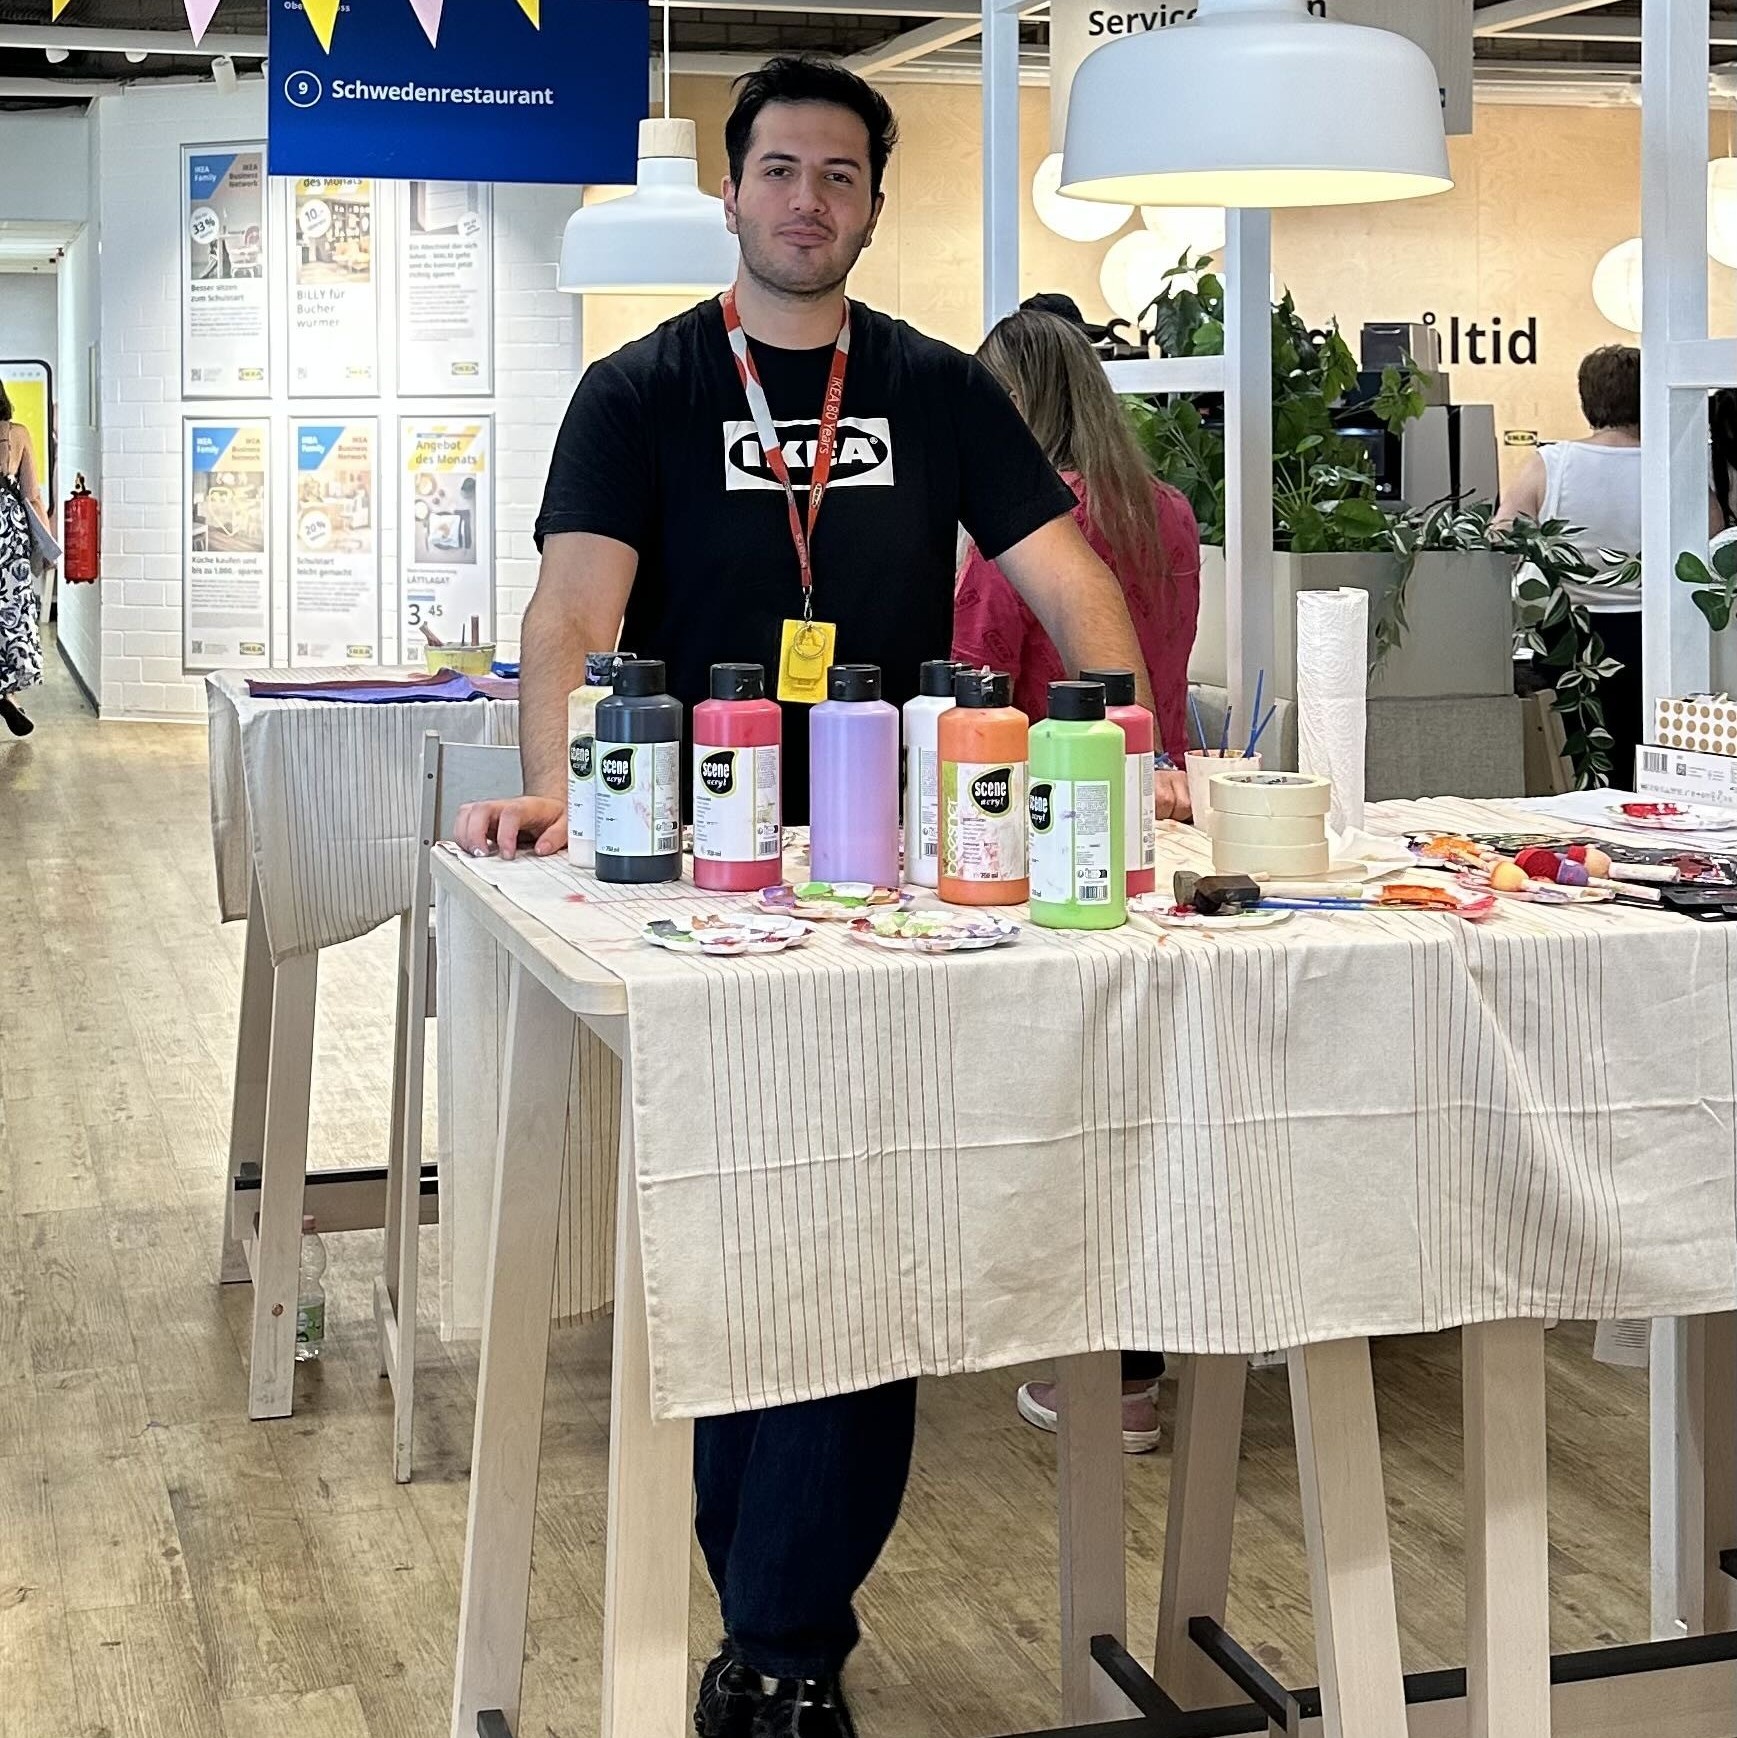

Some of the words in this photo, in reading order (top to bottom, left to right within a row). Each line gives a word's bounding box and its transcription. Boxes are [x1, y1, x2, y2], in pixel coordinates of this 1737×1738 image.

[298, 81, 308, 95] 9
[331, 79, 554, 105] Schwedenrestaurant
[296, 289, 326, 300] BILLY
[827, 376, 843, 401] IKEA
[823, 404, 839, 420] 80
[416, 440, 461, 452] Angebot
[819, 422, 836, 455] Years
[415, 454, 434, 464] des
[437, 454, 478, 464] Monats
[408, 604, 421, 625] 3
[602, 759, 629, 775] scene
[702, 762, 730, 778] scene
[606, 774, 626, 786] acryl
[706, 778, 727, 788] acryl
[974, 781, 1007, 797] scene
[980, 797, 1004, 807] acryl
